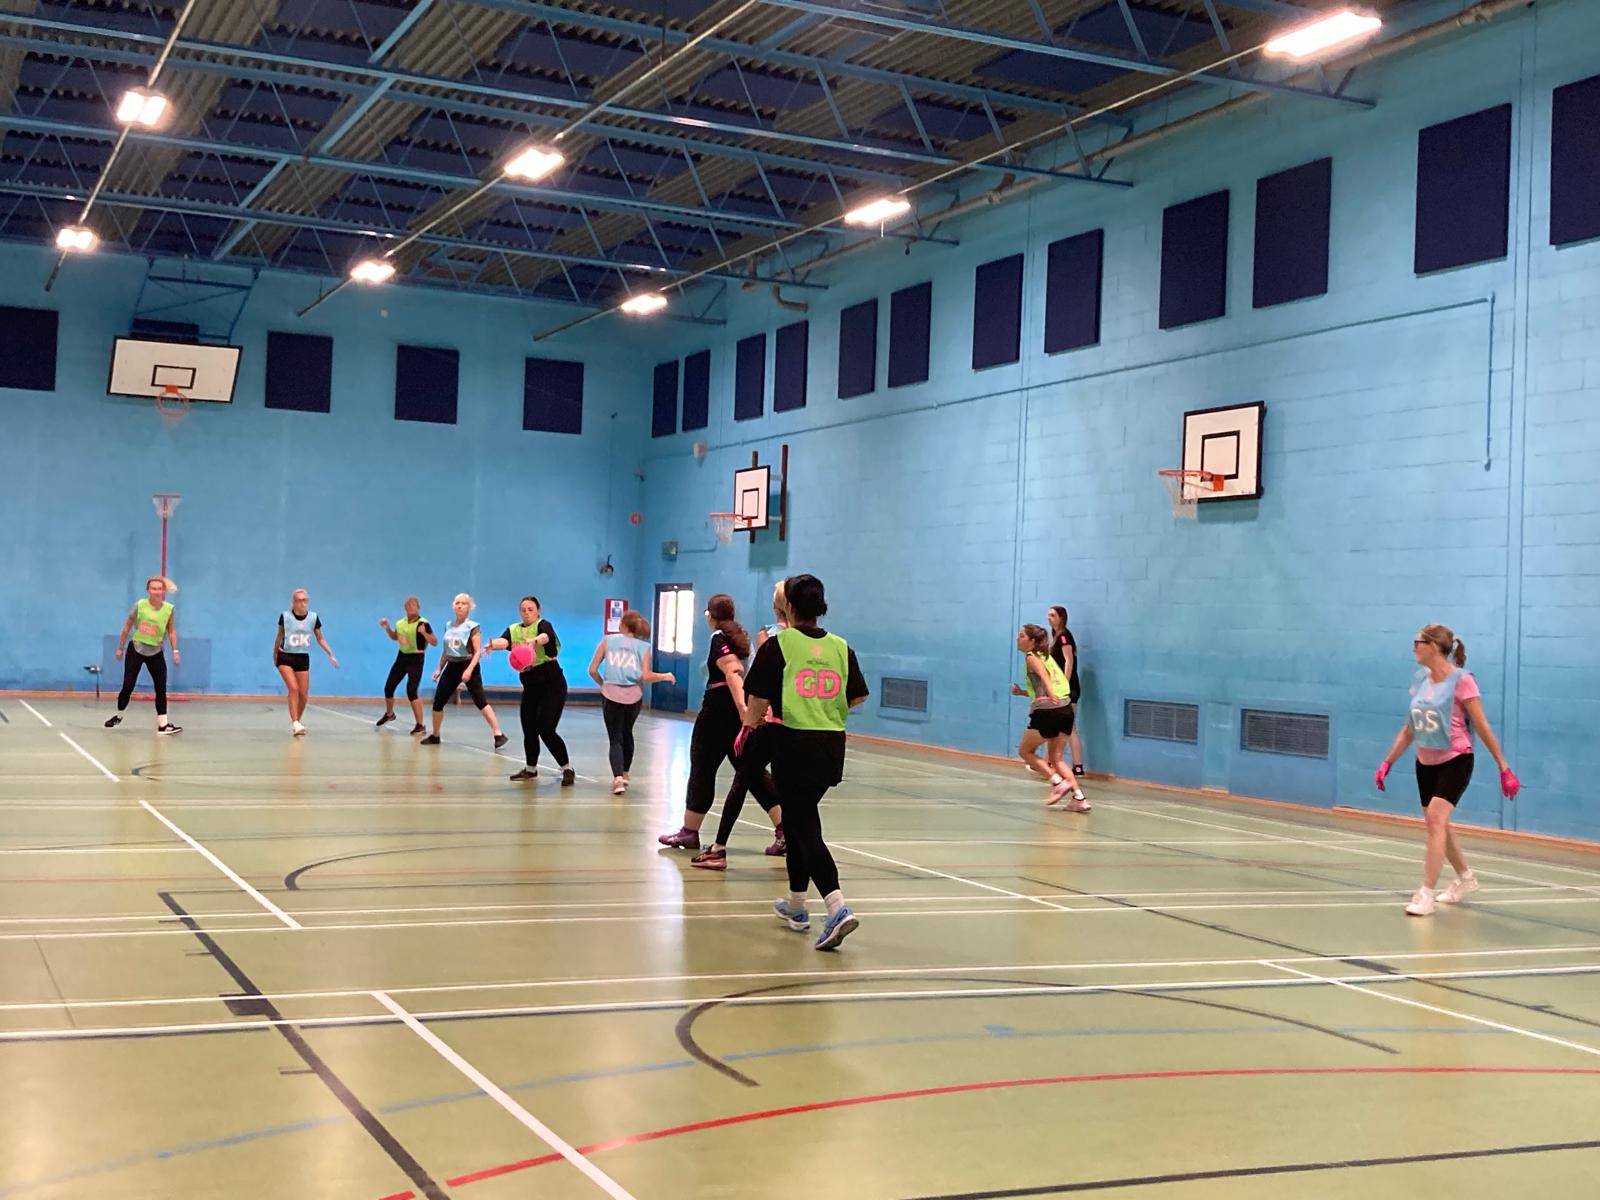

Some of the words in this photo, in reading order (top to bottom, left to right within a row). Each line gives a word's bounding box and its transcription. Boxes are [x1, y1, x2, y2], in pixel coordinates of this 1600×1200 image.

[289, 634, 310, 647] GK
[607, 652, 637, 671] WA
[795, 668, 841, 699] GD
